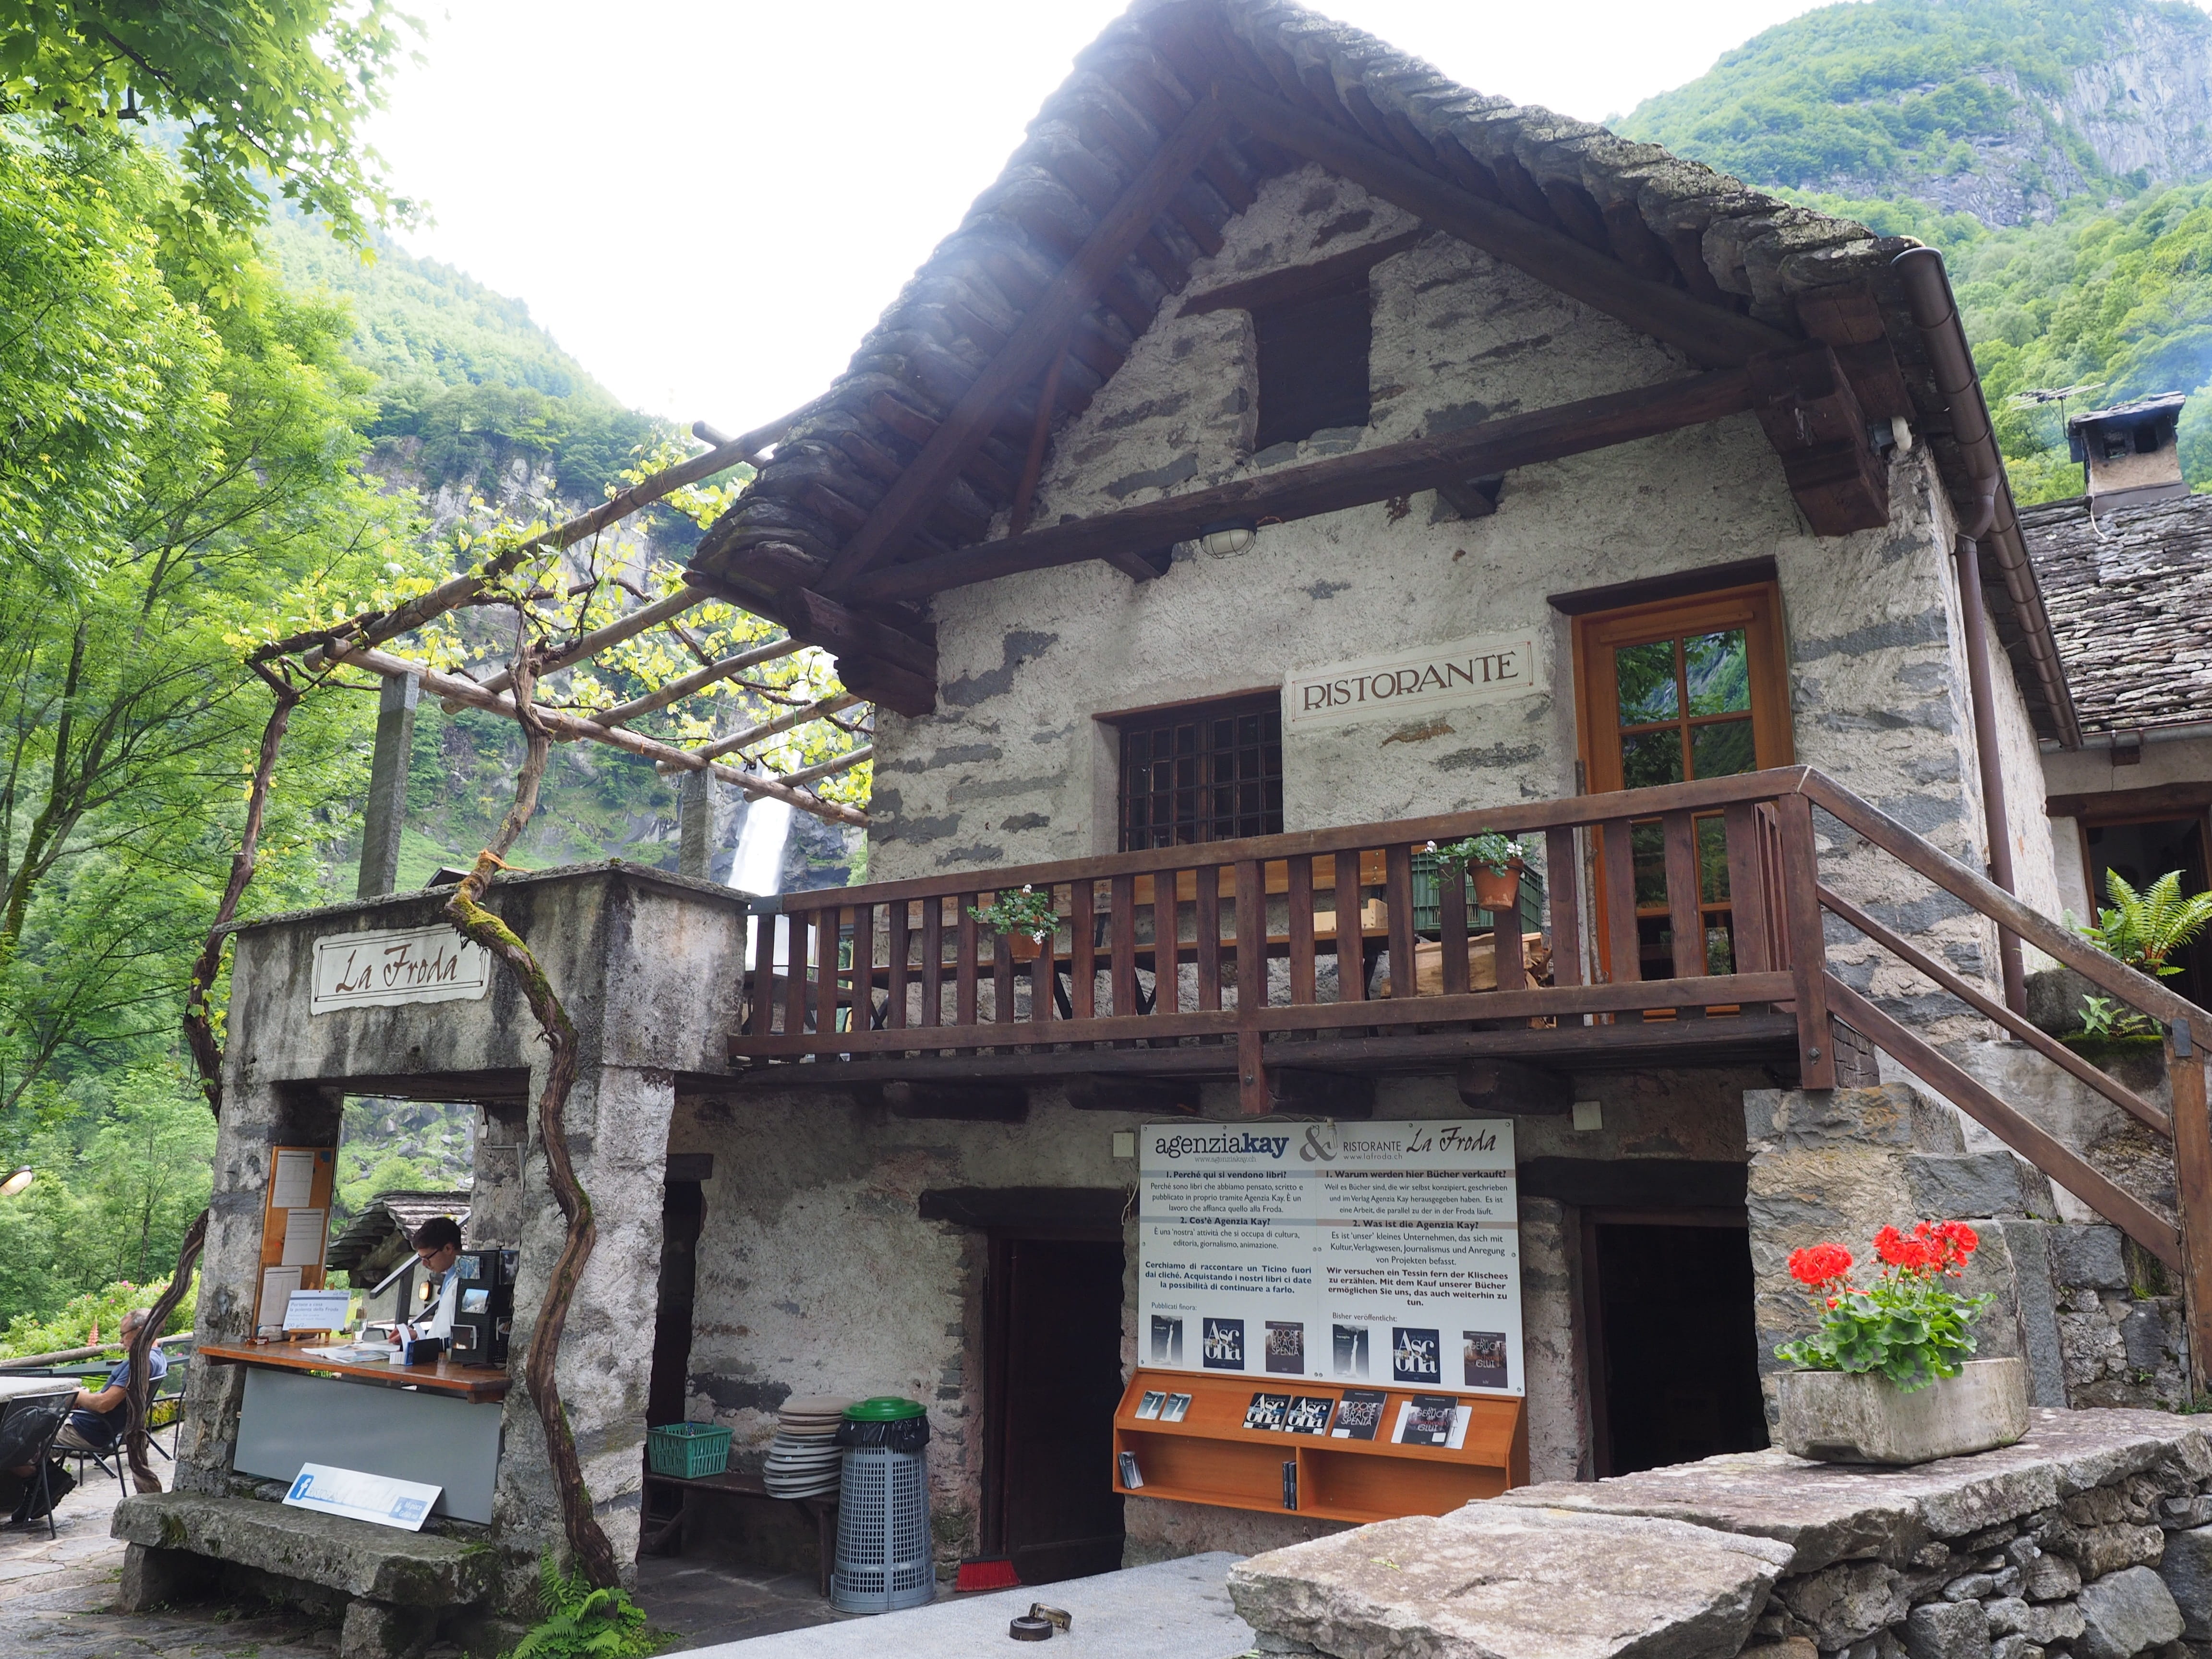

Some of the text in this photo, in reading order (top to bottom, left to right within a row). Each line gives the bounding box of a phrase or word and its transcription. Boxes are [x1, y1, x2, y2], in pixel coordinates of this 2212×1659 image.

[1303, 650, 1519, 711] RISTORANTE
[336, 943, 458, 994] La Froda
[1155, 1133, 1289, 1159] agenziakay
[1343, 1141, 1401, 1152] RISTORANTE
[1406, 1128, 1432, 1152] La
[1440, 1127, 1496, 1152] Froda
[1203, 1171, 1216, 1180] qui
[1432, 1184, 1467, 1192] konzipiert,
[1468, 1184, 1507, 1192] geschrieben
[1351, 1195, 1370, 1203] Verlag
[1371, 1196, 1395, 1204] Agenzia
[1397, 1196, 1408, 1204] Kay
[1410, 1196, 1458, 1204] herausgegeben
[1228, 1205, 1248, 1214] quello
[1387, 1207, 1410, 1215] parallel
[1214, 1217, 1248, 1226] Agenzia
[1251, 1218, 1271, 1227] Kay?
[1399, 1220, 1414, 1228] die
[1416, 1221, 1454, 1230] Agenzia
[1457, 1222, 1479, 1231] Kay?
[1200, 1240, 1238, 1249] giornalismo,
[1353, 1243, 1402, 1253] Verlagswesen,
[1403, 1245, 1450, 1253] Journalismus
[1468, 1246, 1505, 1256] Anregung
[1391, 1256, 1426, 1266] Projekten
[1145, 1261, 1185, 1270] Cerchiamo
[1262, 1265, 1287, 1273] Ticino
[1184, 1273, 1233, 1281] Acquistando
[1344, 1267, 1384, 1275] versuchen
[1467, 1271, 1508, 1279] Klischees
[1475, 1281, 1506, 1289] Bücher
[1328, 1286, 1378, 1295] ermöglichen
[1453, 1290, 1494, 1299] weiterhin
[1179, 1303, 1197, 1311] finora:
[1354, 1314, 1397, 1322] veröffentlicht:
[1271, 1329, 1299, 1339] ODORE
[1272, 1338, 1299, 1348] BRACE
[1271, 1347, 1299, 1356] SPENTA
[1347, 1401, 1378, 1411] ODORE
[1344, 1409, 1375, 1419] BRACE
[1341, 1417, 1371, 1426] SPENTA
